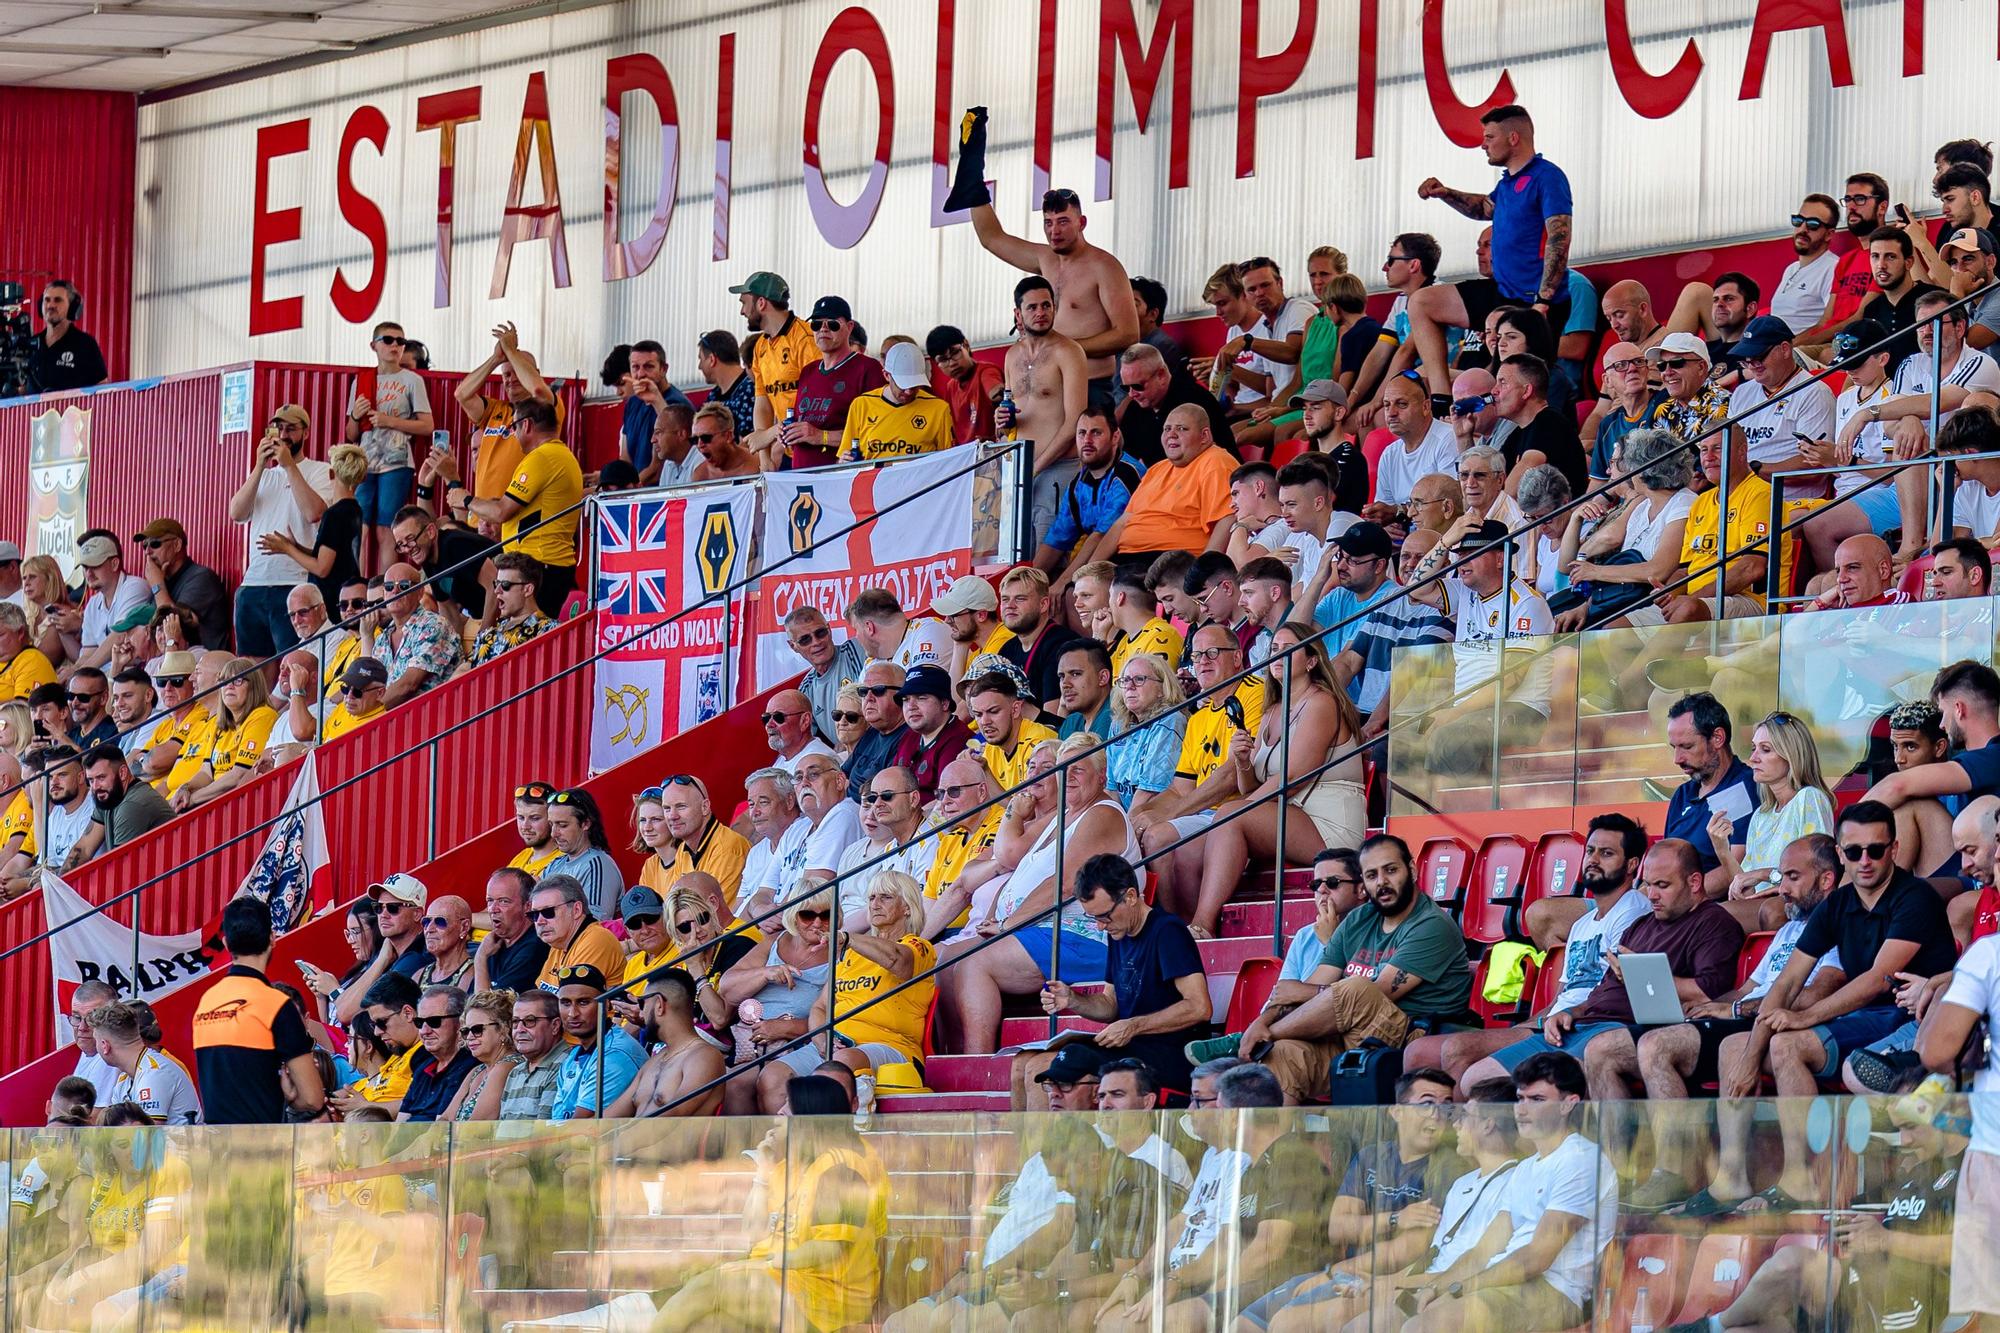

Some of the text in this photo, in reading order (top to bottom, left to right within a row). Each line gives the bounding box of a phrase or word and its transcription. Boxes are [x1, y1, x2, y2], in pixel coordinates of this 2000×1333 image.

[249, 33, 736, 336] ESTADI
[39, 522, 74, 558] NUCÍA
[601, 622, 680, 651] STAFFORD
[76, 946, 214, 999] RALPH
[1887, 1195, 1926, 1216] beko
